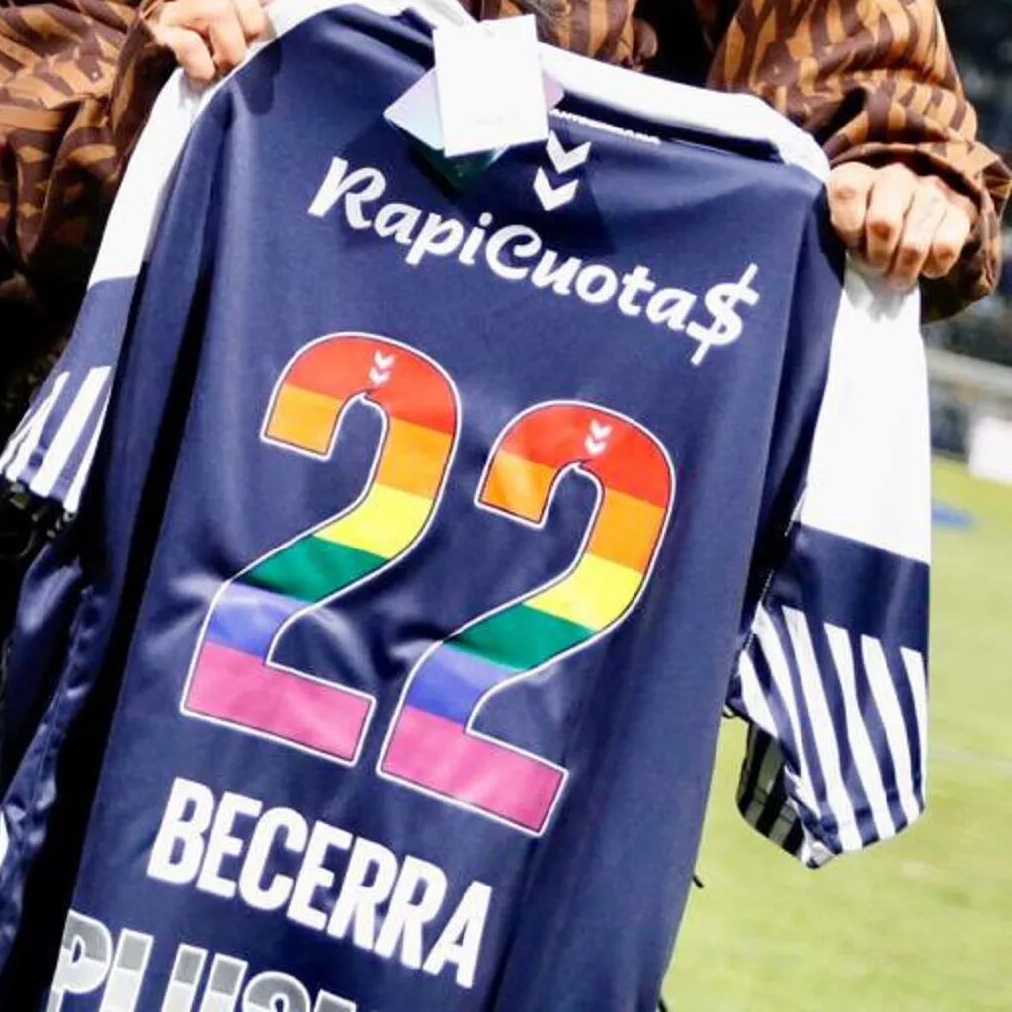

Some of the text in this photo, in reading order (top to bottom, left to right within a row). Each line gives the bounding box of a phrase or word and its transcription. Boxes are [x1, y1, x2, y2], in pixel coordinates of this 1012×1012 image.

[307, 156, 760, 366] RapiCuota$
[181, 331, 676, 836] 22
[146, 777, 493, 988] BECERRA
